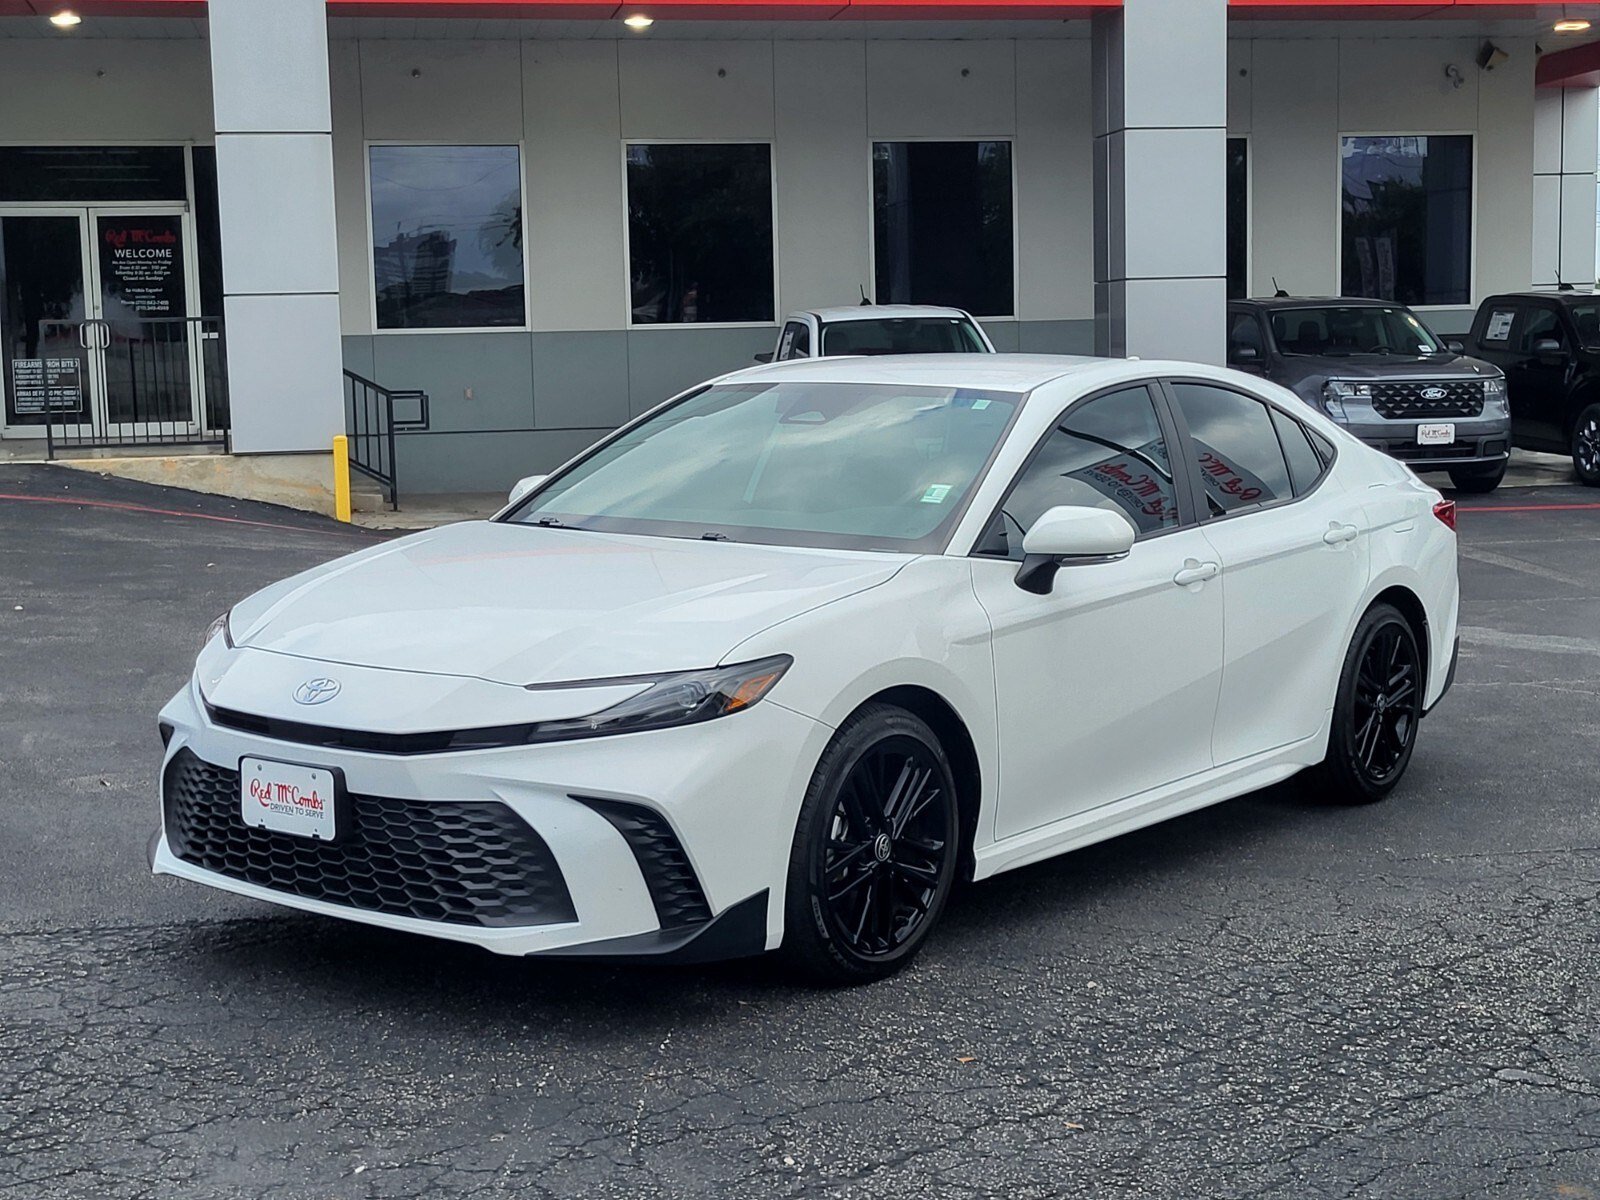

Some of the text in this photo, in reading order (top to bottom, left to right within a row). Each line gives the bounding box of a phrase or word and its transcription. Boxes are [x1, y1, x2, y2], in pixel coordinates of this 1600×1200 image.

[105, 229, 127, 247] Red
[114, 248, 172, 258] WELCOME
[250, 778, 323, 810] Red McCombs
[270, 802, 324, 819] DRIVEN TO SERVE
